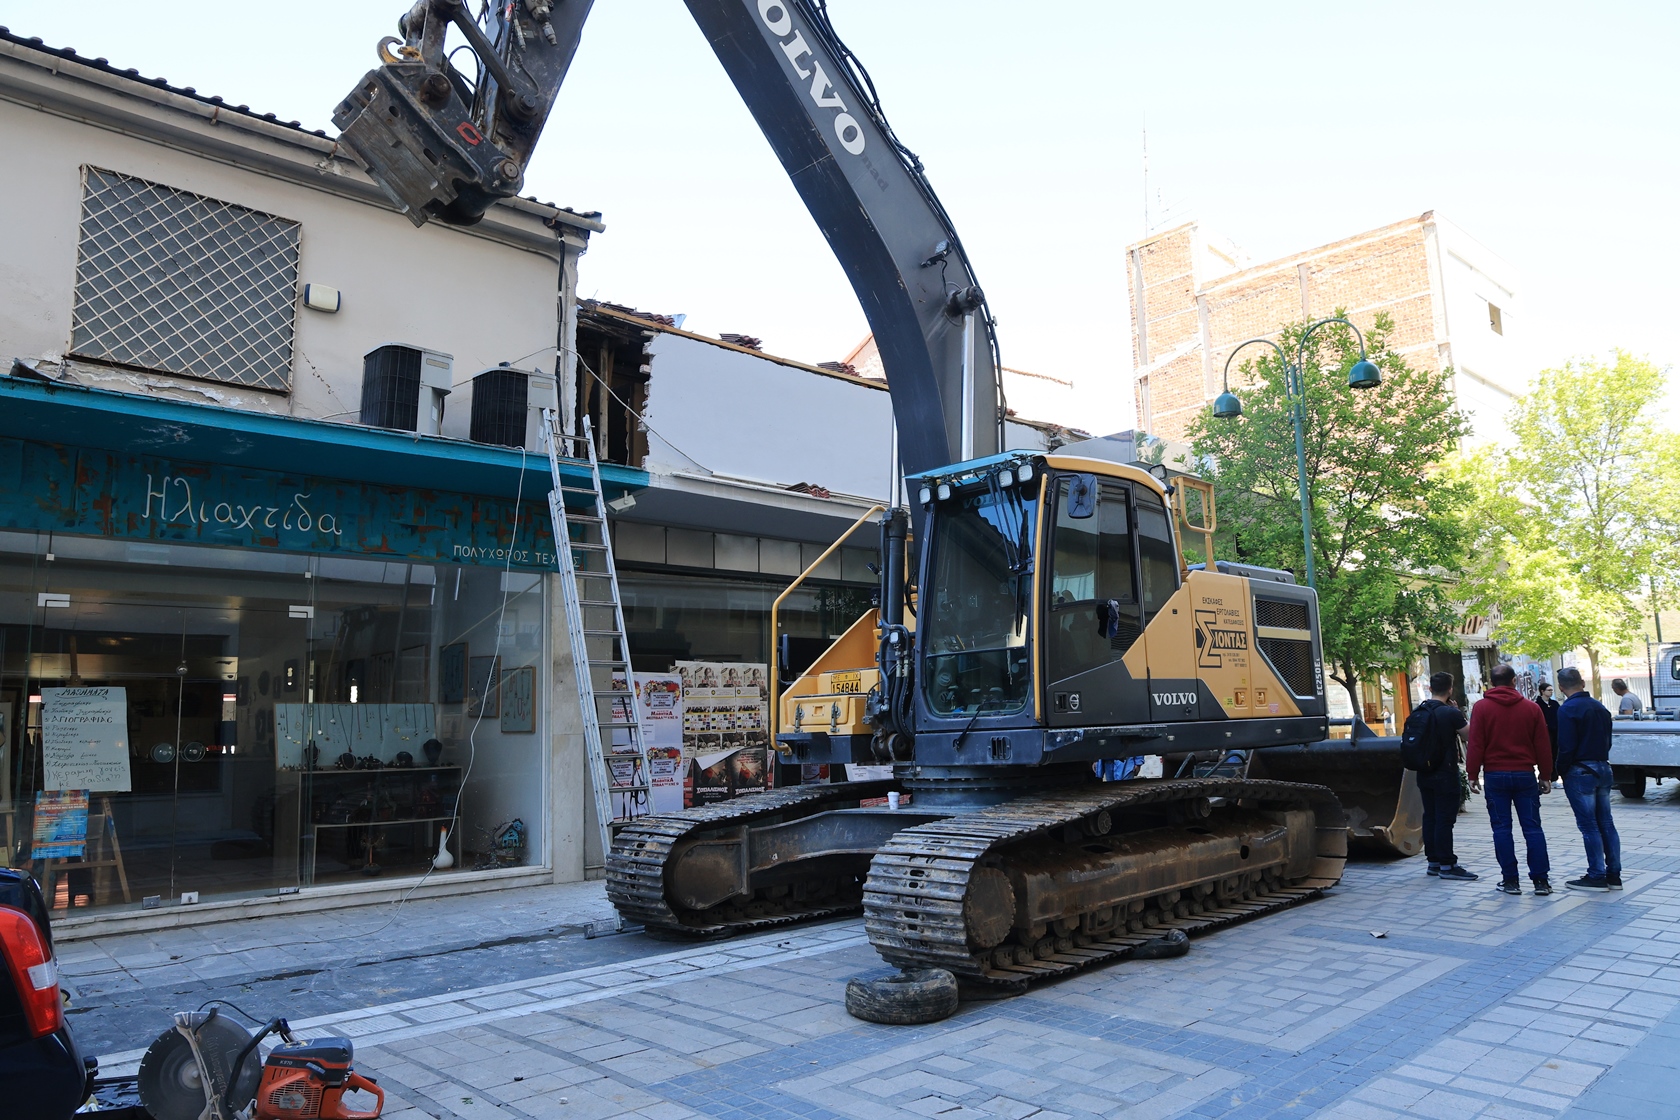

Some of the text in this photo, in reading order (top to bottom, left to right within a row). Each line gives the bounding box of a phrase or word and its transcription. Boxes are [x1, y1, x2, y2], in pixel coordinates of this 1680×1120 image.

[141, 473, 342, 536] Ηλιαχτίδα
[453, 544, 581, 568] ΠΟΛΥΧΩΡΟΣ ΤΕΧΣ
[1152, 692, 1197, 706] VOLVO
